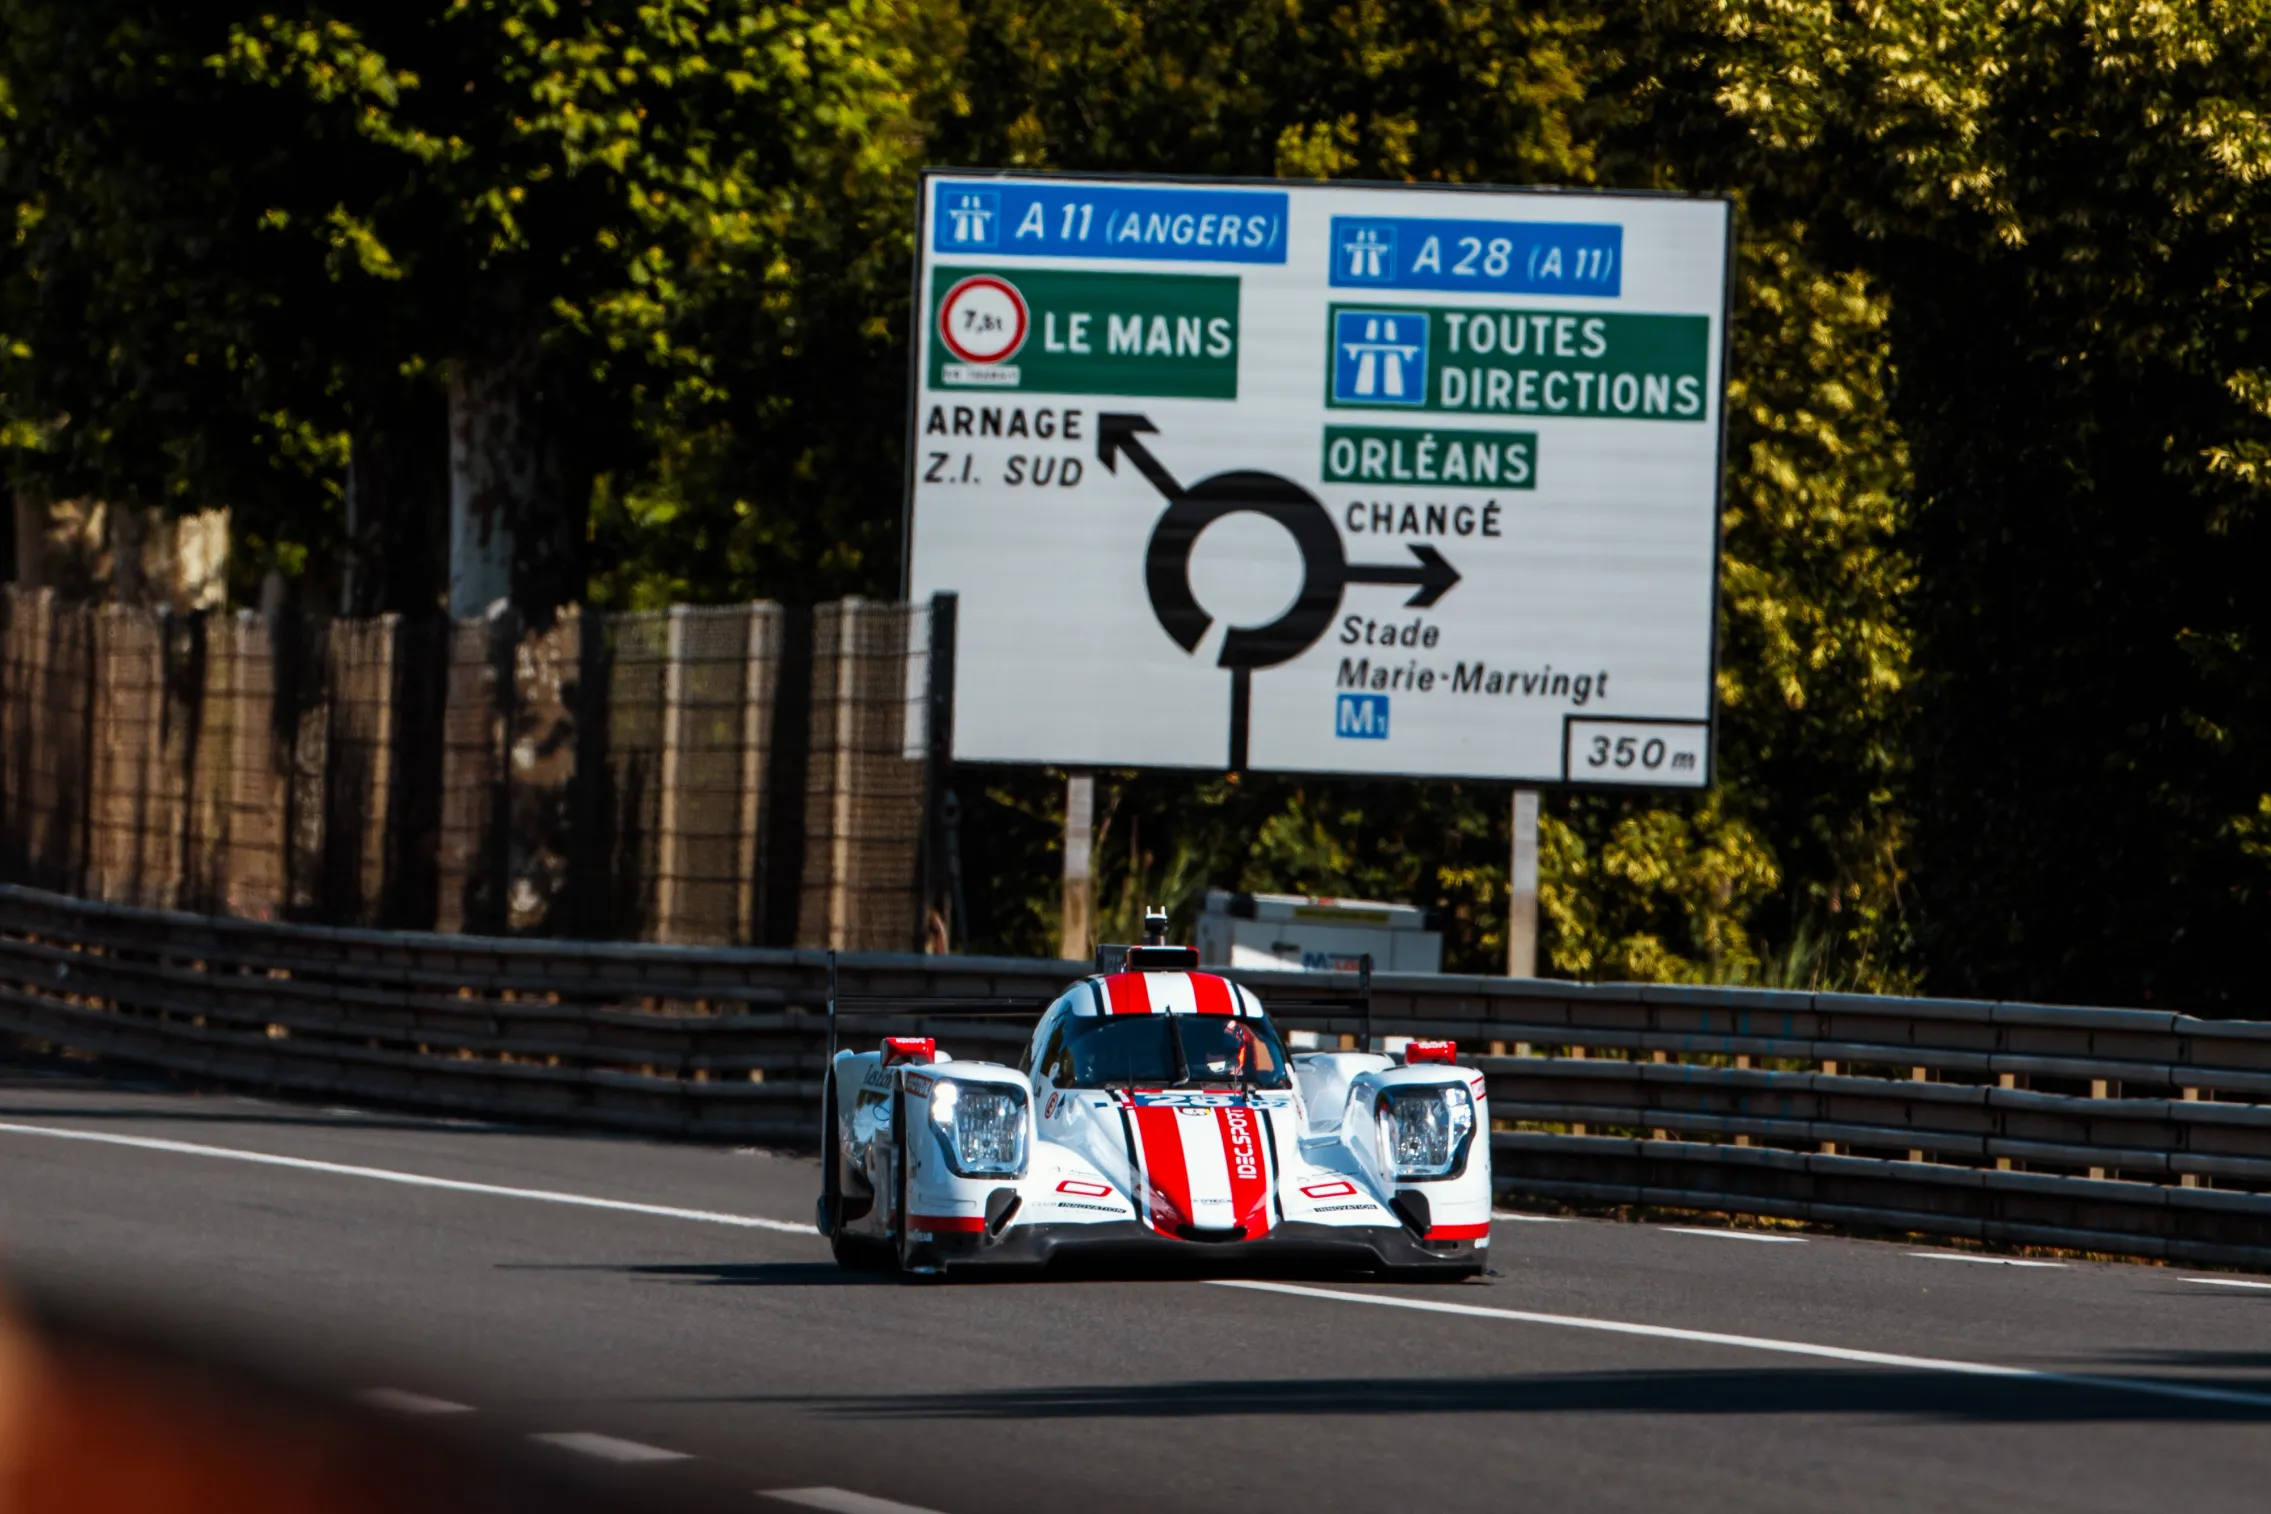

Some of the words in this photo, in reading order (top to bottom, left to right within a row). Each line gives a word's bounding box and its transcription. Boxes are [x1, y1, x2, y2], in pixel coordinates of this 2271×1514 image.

[1015, 201, 1045, 240] A
[1059, 203, 1093, 241] 11
[1105, 209, 1281, 252] (ANGERS)
[1411, 235, 1441, 274] A
[1452, 237, 1512, 277] 28
[1527, 244, 1562, 283] (A
[1574, 247, 1613, 283] 11)
[1044, 312, 1092, 353] LE
[1107, 314, 1232, 359] MANS
[1444, 313, 1607, 358] TOUTES
[1440, 367, 1701, 415] DIRECTIONS
[926, 405, 1083, 440] ARNAGE
[924, 452, 981, 485] Z.I.
[1004, 454, 1084, 488] SUD
[1328, 434, 1530, 483] ORLÉANS
[1346, 500, 1502, 537] CHANGÉ
[1340, 615, 1440, 649] Stade
[1336, 657, 1608, 705] Marie-Marvingt
[1587, 735, 1666, 770] 350
[1671, 750, 1696, 770] m
[1143, 1094, 1234, 1107] 28
[1225, 1108, 1257, 1180] IDEC.SPORT
